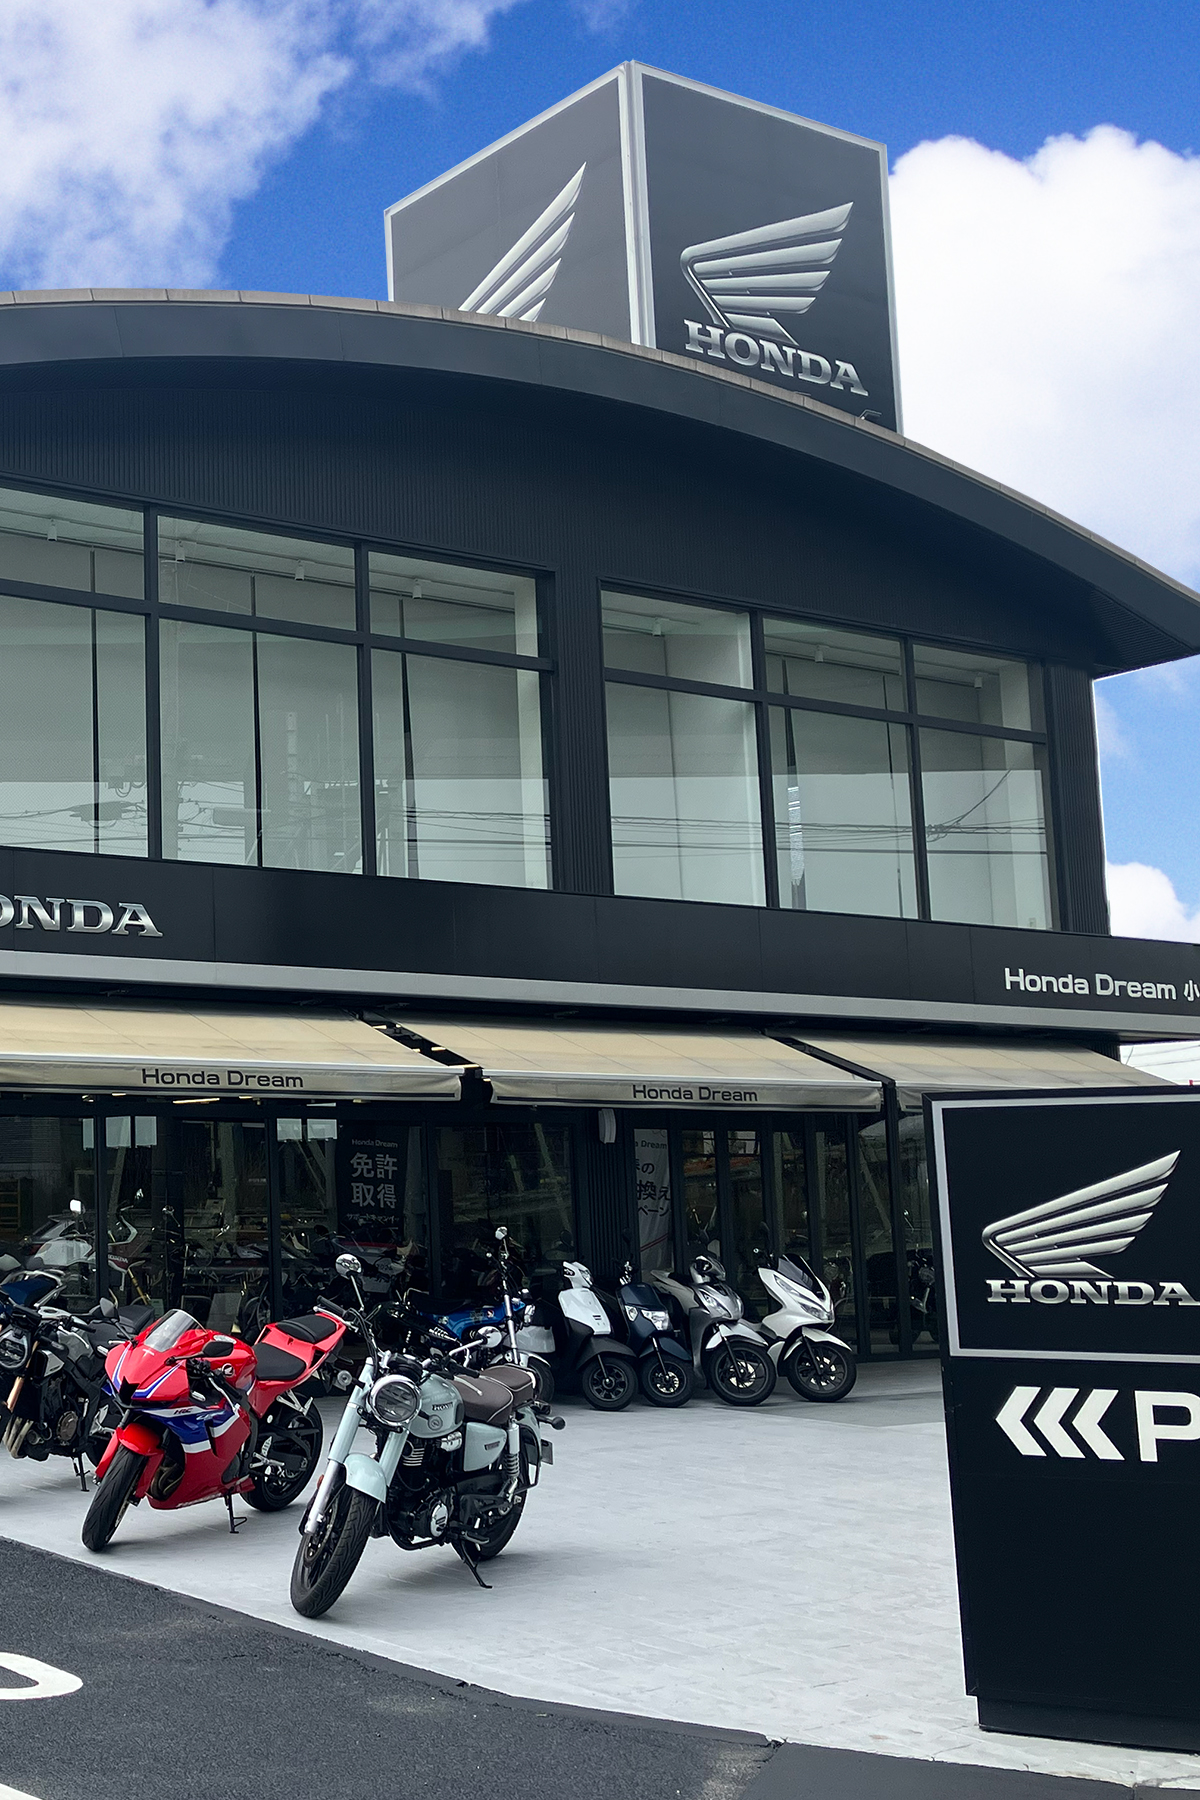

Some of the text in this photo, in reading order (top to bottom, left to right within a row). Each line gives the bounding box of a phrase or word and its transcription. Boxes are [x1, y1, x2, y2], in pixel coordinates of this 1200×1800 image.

[684, 319, 869, 397] HONDA
[1004, 967, 1090, 995] Honda
[1095, 973, 1177, 1001] Dream
[141, 1068, 304, 1088] Honda Dream
[632, 1084, 758, 1102] Honda Dream
[351, 1138, 398, 1148] Honda Dream
[641, 1140, 667, 1150] Dream
[350, 1152, 398, 1180] 免許
[350, 1182, 397, 1209] 取得
[985, 1278, 1200, 1306] HONDA
